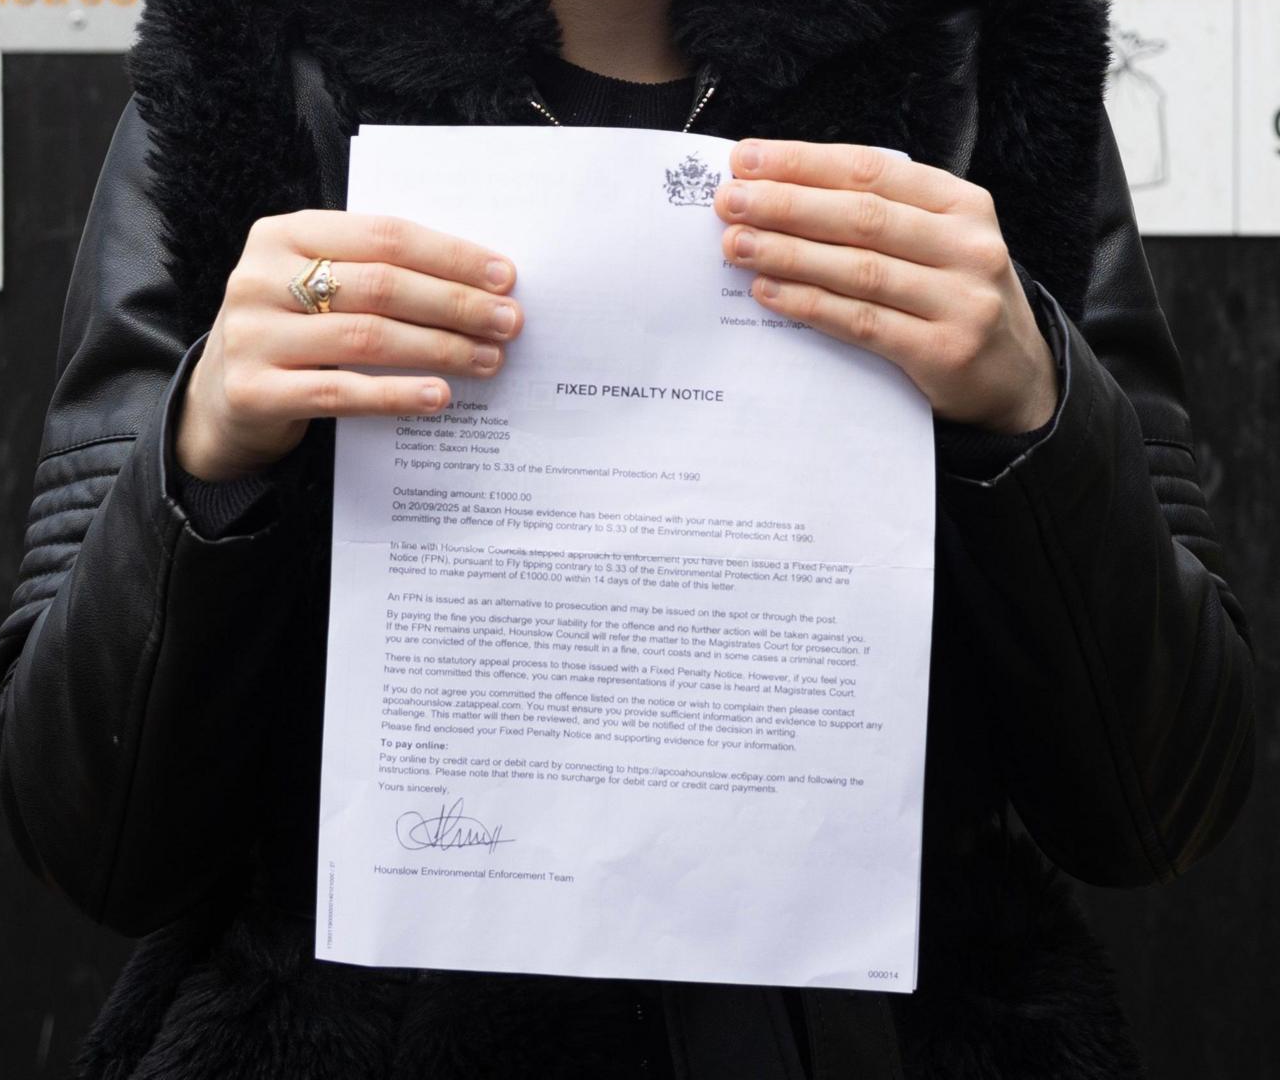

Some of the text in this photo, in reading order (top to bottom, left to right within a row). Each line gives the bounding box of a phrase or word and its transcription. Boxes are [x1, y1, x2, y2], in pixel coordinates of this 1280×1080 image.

[721, 287, 746, 297] Date:
[720, 316, 760, 327] Website:
[556, 383, 724, 402] FIXED PENALTY NOTICE
[456, 401, 489, 411] Forbes
[443, 415, 478, 427] Penalty
[480, 416, 509, 426] Notice
[396, 427, 432, 437] Offence
[439, 442, 468, 453] Saxon
[470, 444, 500, 454] House
[394, 458, 408, 470] Fly
[410, 459, 441, 471] tipping
[443, 460, 480, 473] contrary
[482, 462, 491, 471] to
[516, 464, 526, 473] of
[528, 464, 543, 474] the
[545, 465, 610, 477] Environmental
[612, 468, 658, 479] Protection
[660, 470, 675, 479] Act
[679, 471, 701, 480] 1990
[392, 487, 448, 499] Outstanding
[392, 501, 406, 510] On
[461, 504, 471, 513] at
[473, 504, 502, 514] Saxon
[504, 506, 534, 516] House
[535, 507, 577, 518] evidence
[579, 509, 596, 519] has
[598, 510, 621, 520] been
[623, 511, 662, 522] obtained
[665, 514, 683, 523] with
[685, 517, 705, 527] your
[707, 518, 734, 526] name
[735, 518, 753, 527] and
[755, 519, 792, 530] address
[391, 513, 441, 526] committing
[443, 516, 458, 525] the
[459, 516, 493, 527] offence
[495, 518, 505, 527] of
[506, 519, 521, 530] Fly
[523, 520, 553, 532] tipping
[555, 521, 592, 534] contrary
[594, 523, 604, 532] to
[629, 525, 638, 534] of
[640, 526, 655, 535] the
[657, 526, 723, 538] Environmental
[724, 530, 771, 541] Protection
[772, 532, 788, 542] Act
[388, 566, 426, 578] required
[428, 567, 438, 576] to
[439, 568, 465, 578] make
[466, 569, 507, 581] payment
[508, 571, 518, 580] of
[564, 573, 591, 583] within
[595, 575, 605, 584] 14
[607, 575, 629, 587] days
[631, 576, 640, 586] of
[642, 577, 657, 586] the
[659, 578, 680, 588] date
[681, 579, 691, 588] of
[693, 579, 709, 589] this
[387, 592, 400, 601] An
[402, 593, 423, 603] FPN
[425, 594, 433, 603] is
[435, 594, 465, 605] issued
[494, 597, 542, 608] alternative
[544, 600, 554, 609] to
[555, 600, 608, 614] prosecution
[610, 603, 628, 613] and
[629, 606, 649, 616] may
[651, 605, 663, 614] be
[665, 606, 696, 616] issued
[697, 609, 709, 617] on
[711, 608, 726, 618] the
[728, 609, 748, 621] spot
[762, 611, 797, 623] through
[799, 613, 814, 622] the
[383, 664, 406, 674] have
[408, 665, 423, 675] not
[425, 666, 472, 677] committed
[474, 669, 491, 678] this
[532, 674, 549, 683] you
[550, 674, 568, 682] can
[569, 673, 595, 684] make
[597, 675, 667, 689] representations
[669, 678, 675, 688] if
[677, 681, 697, 691] your
[699, 682, 722, 690] case
[723, 681, 732, 690] is
[733, 682, 760, 692] heard
[762, 683, 772, 692] at
[774, 684, 826, 697] Magistrates
[381, 722, 412, 731] Please
[414, 723, 431, 732] find
[433, 723, 475, 734] enclosed
[477, 727, 497, 737] your
[499, 726, 524, 736] Fixed
[526, 727, 561, 740] Penalty
[563, 729, 592, 739] Notice
[594, 731, 612, 740] and
[614, 732, 661, 745] supporting
[663, 734, 705, 745] evidence
[706, 737, 719, 746] for
[721, 739, 741, 750] your
[381, 738, 393, 748] To
[395, 741, 413, 751] pay
[435, 767, 467, 777] Please
[468, 768, 489, 778] note
[491, 769, 509, 778] that
[511, 770, 534, 780] there
[536, 771, 545, 780] is
[546, 773, 559, 781] no
[561, 772, 606, 785] surcharge
[608, 774, 620, 784] for
[622, 775, 645, 785] debit
[647, 777, 668, 786] card
[681, 778, 707, 789] credit
[709, 780, 729, 790] card
[379, 782, 405, 791] Yours
[373, 865, 574, 882] Hounslow Environmental Enforcement Team
[867, 970, 899, 980] 000014
